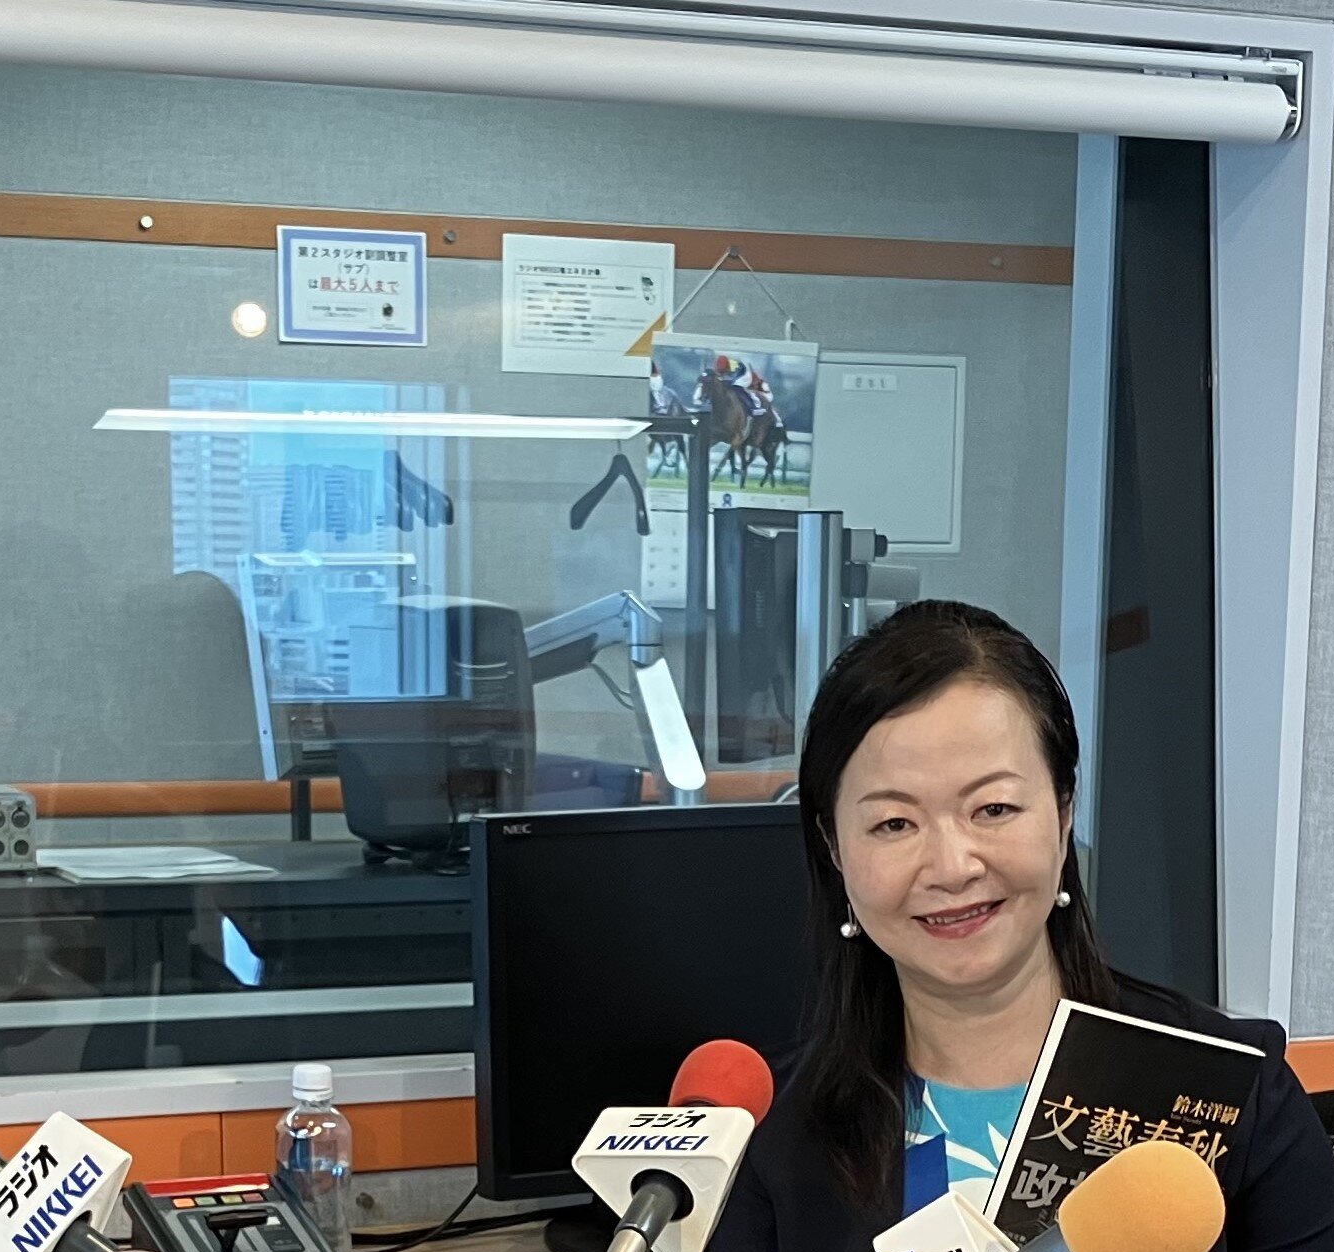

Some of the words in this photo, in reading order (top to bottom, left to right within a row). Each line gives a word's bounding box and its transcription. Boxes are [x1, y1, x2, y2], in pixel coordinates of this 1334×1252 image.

[503, 824, 532, 835] NEC
[628, 1110, 707, 1128] ラジオ
[595, 1135, 709, 1151] NIKKEI
[1012, 1159, 1089, 1208] 政
